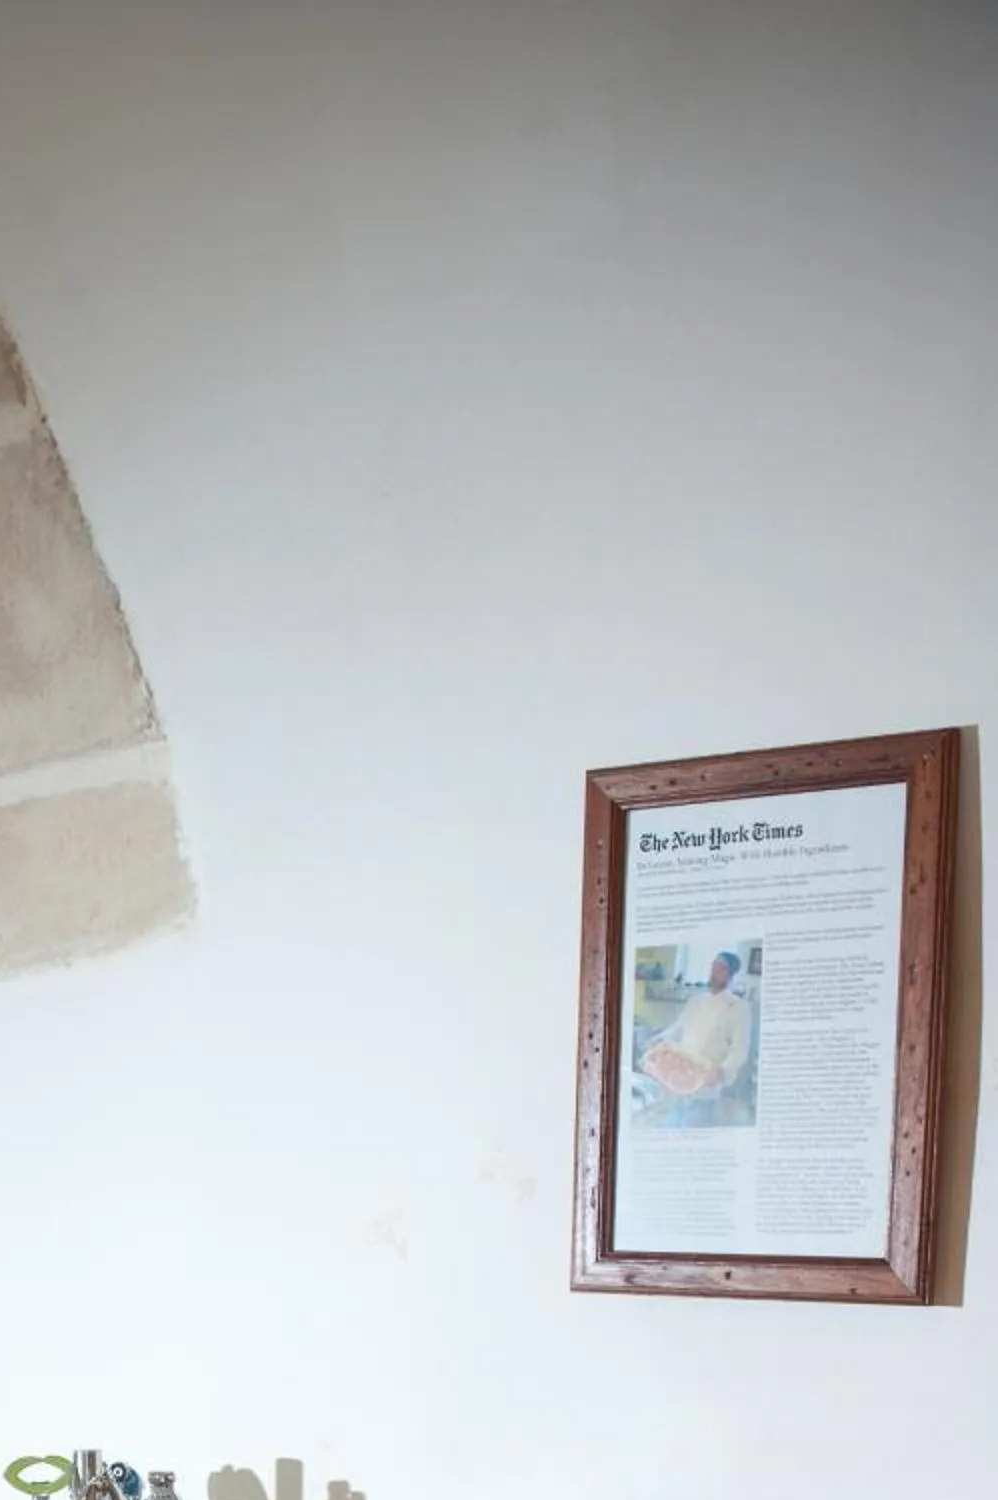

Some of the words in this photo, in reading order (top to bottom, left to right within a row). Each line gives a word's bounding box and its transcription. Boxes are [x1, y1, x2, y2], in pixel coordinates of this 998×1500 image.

[639, 832, 670, 852] The
[671, 831, 706, 851] New
[708, 824, 749, 851] York
[751, 821, 804, 841] Times
